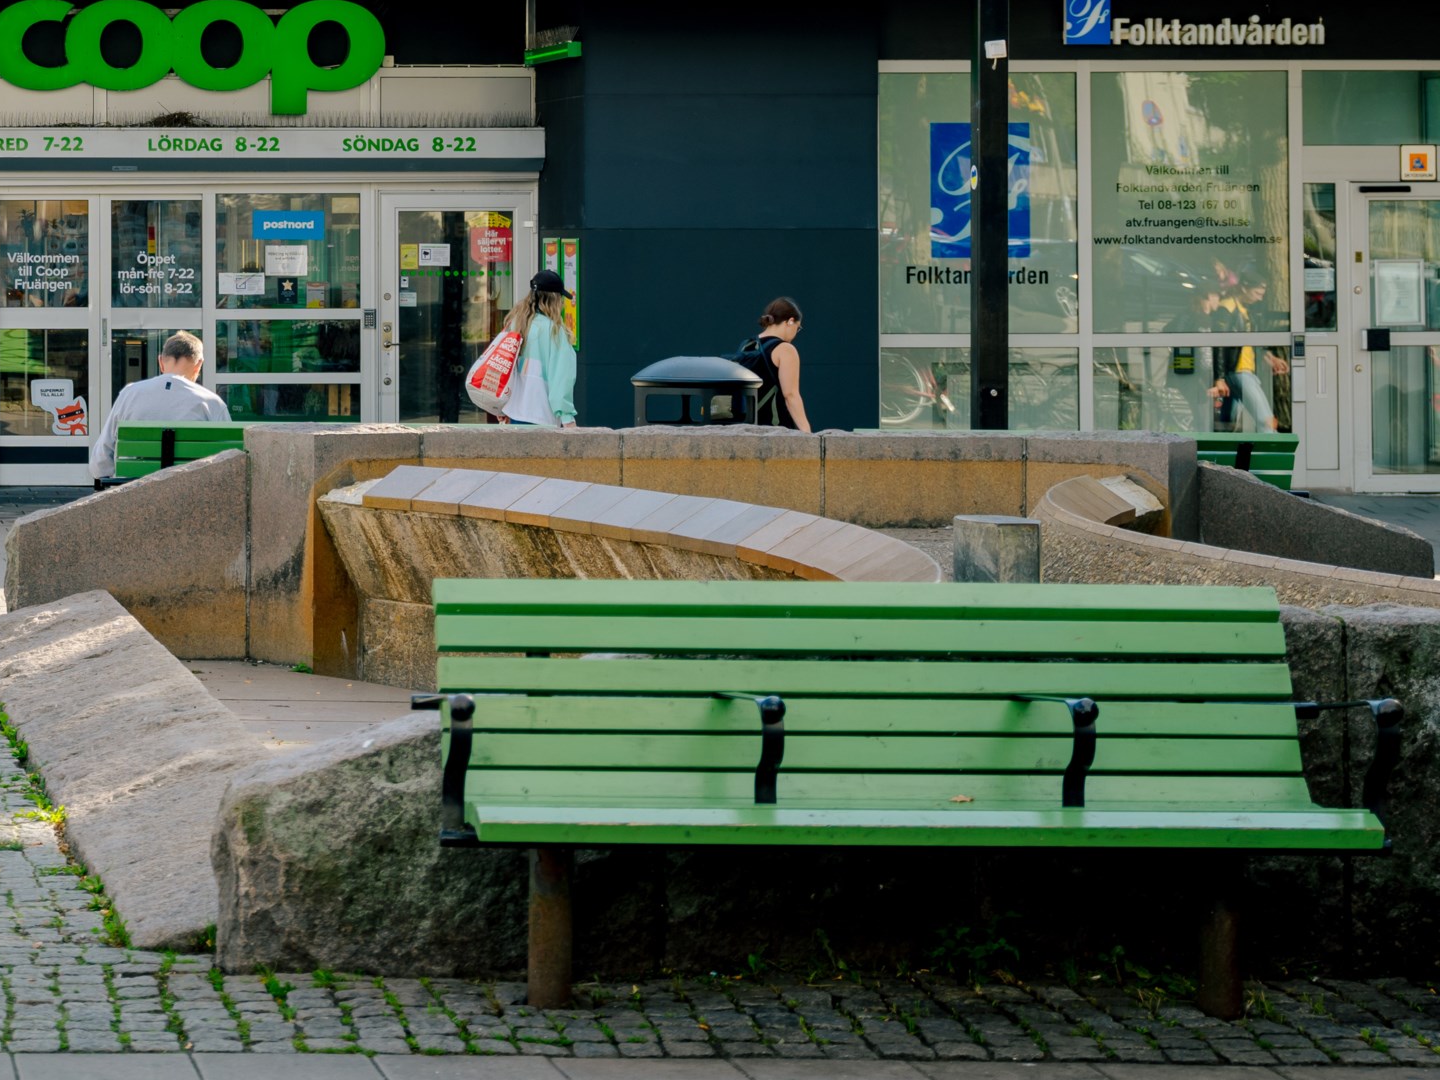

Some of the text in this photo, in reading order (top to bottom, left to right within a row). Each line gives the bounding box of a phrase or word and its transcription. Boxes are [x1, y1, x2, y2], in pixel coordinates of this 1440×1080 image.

[1113, 14, 1325, 45] Folktandvården
[43, 136, 84, 151] 7-22
[147, 134, 280, 152] LÖRDAG 8-22
[342, 134, 477, 152] SÖNDAG 8-22
[1216, 164, 1230, 175] till
[1206, 182, 1260, 195] Fruängen
[1138, 200, 1154, 210] Tel
[1157, 200, 1196, 210] 08-123
[1224, 200, 1238, 210] 00
[263, 220, 314, 230] postnord
[485, 229, 499, 238] Här
[1094, 234, 1284, 246] www.folktandvardenstockholm.se
[7, 252, 80, 263] Välkommen
[136, 251, 176, 267] Öppet
[18, 265, 69, 278] till Coop
[117, 267, 195, 280] mån-fre 7-22
[14, 278, 73, 292] Fruängen
[119, 282, 193, 294] lör-sön 8-22
